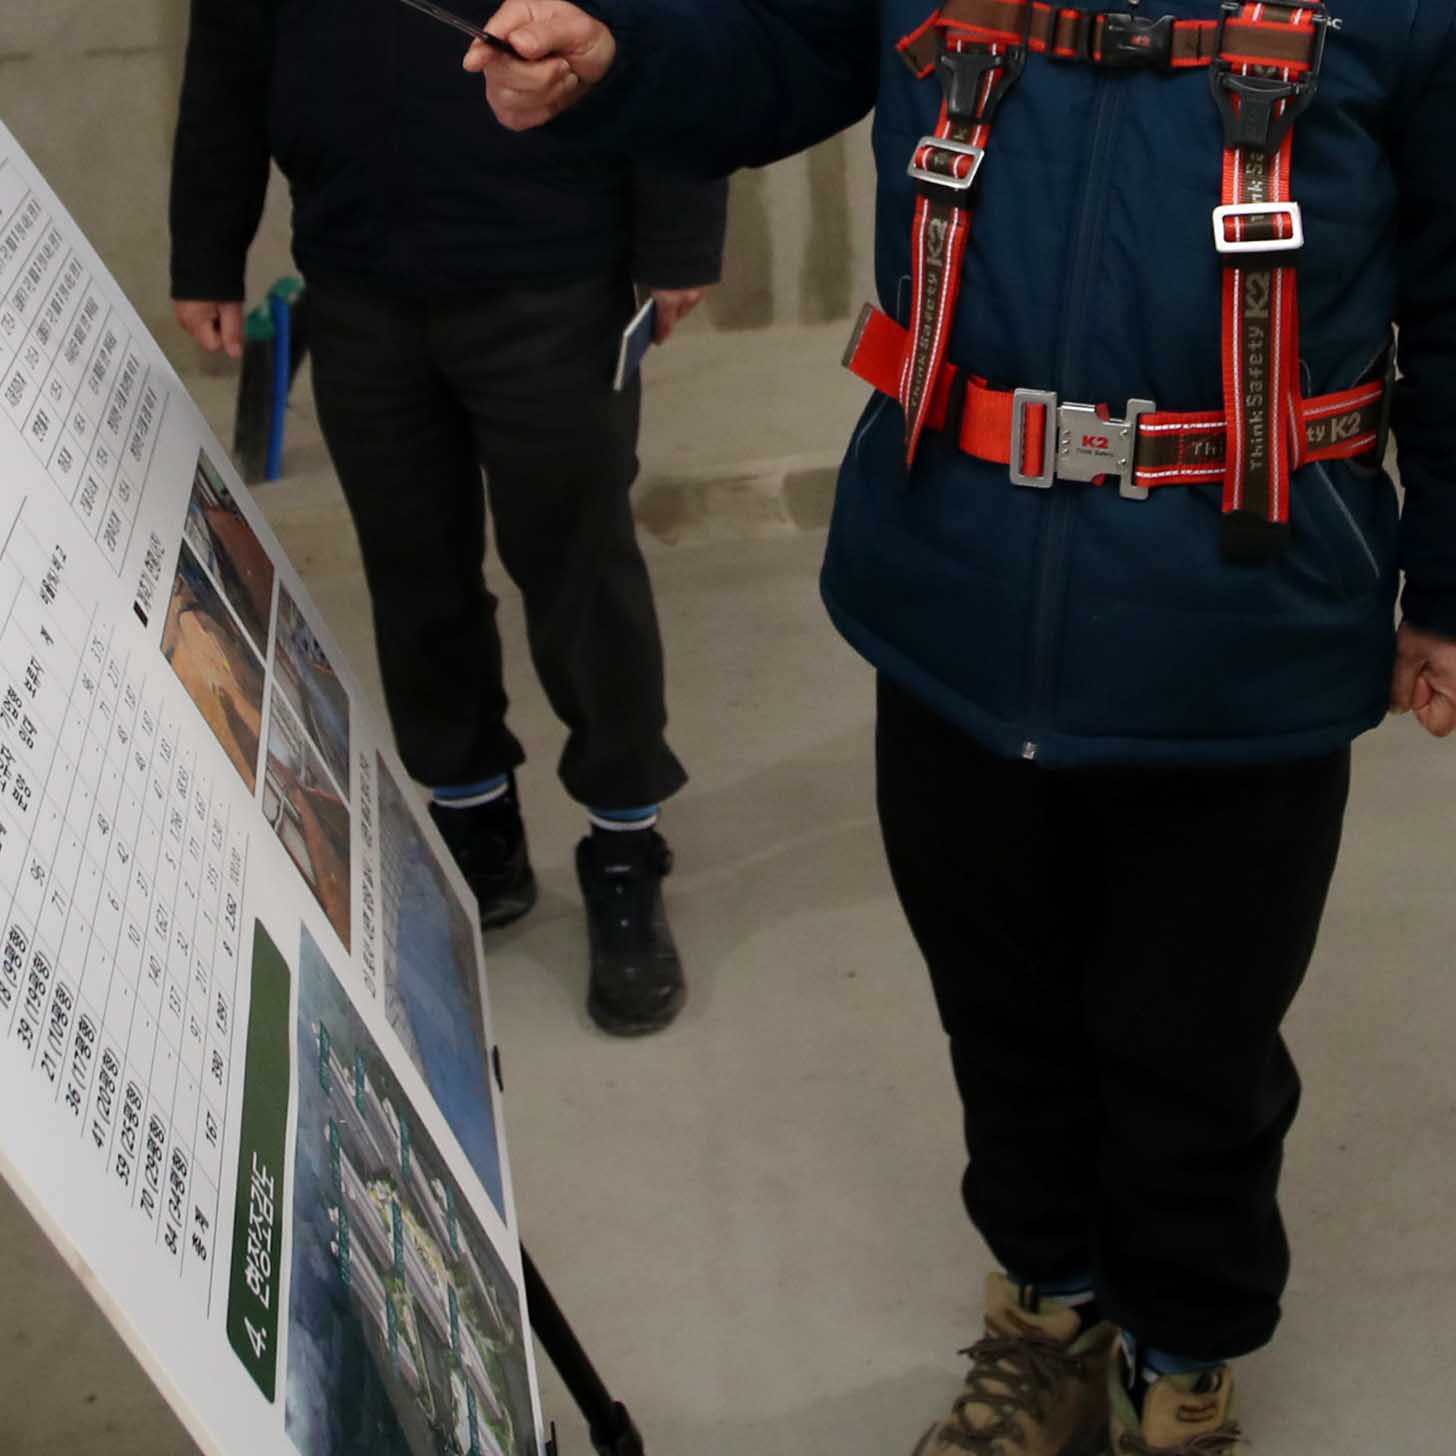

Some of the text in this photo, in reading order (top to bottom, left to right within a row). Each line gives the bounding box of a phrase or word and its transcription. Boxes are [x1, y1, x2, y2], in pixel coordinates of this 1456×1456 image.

[926, 217, 948, 267] K2
[1245, 271, 1271, 320] K2
[1082, 434, 1109, 449] K2
[1330, 411, 1362, 441] K2
[23, 656, 43, 697] 보류지
[0, 685, 22, 728] 기업형
[17, 714, 37, 749] 임대
[11, 773, 31, 811] 분양
[2, 924, 27, 987] (9평형)
[29, 858, 45, 886] 96
[127, 923, 141, 947] 10
[16, 889, 66, 1049] 39 (19평형) 71
[147, 954, 161, 985] 140
[168, 984, 181, 1017] 137
[40, 1050, 56, 1082] 21
[48, 981, 73, 1056] (10평형)
[71, 1013, 95, 1089] (17평형)
[64, 1082, 81, 1116] 36
[96, 1047, 118, 1124] (20평형)
[205, 1110, 217, 1146] 167
[211, 1049, 223, 1085] 390
[91, 1119, 105, 1148] 41
[120, 1080, 142, 1158] (25평형)
[115, 1153, 130, 1186] 59
[144, 1114, 164, 1193] (29평형)
[139, 1188, 154, 1218] 70
[168, 1146, 187, 1227] (34평형)
[164, 1222, 178, 1255] 84
[243, 1150, 275, 1357] 4. 현장조감도
